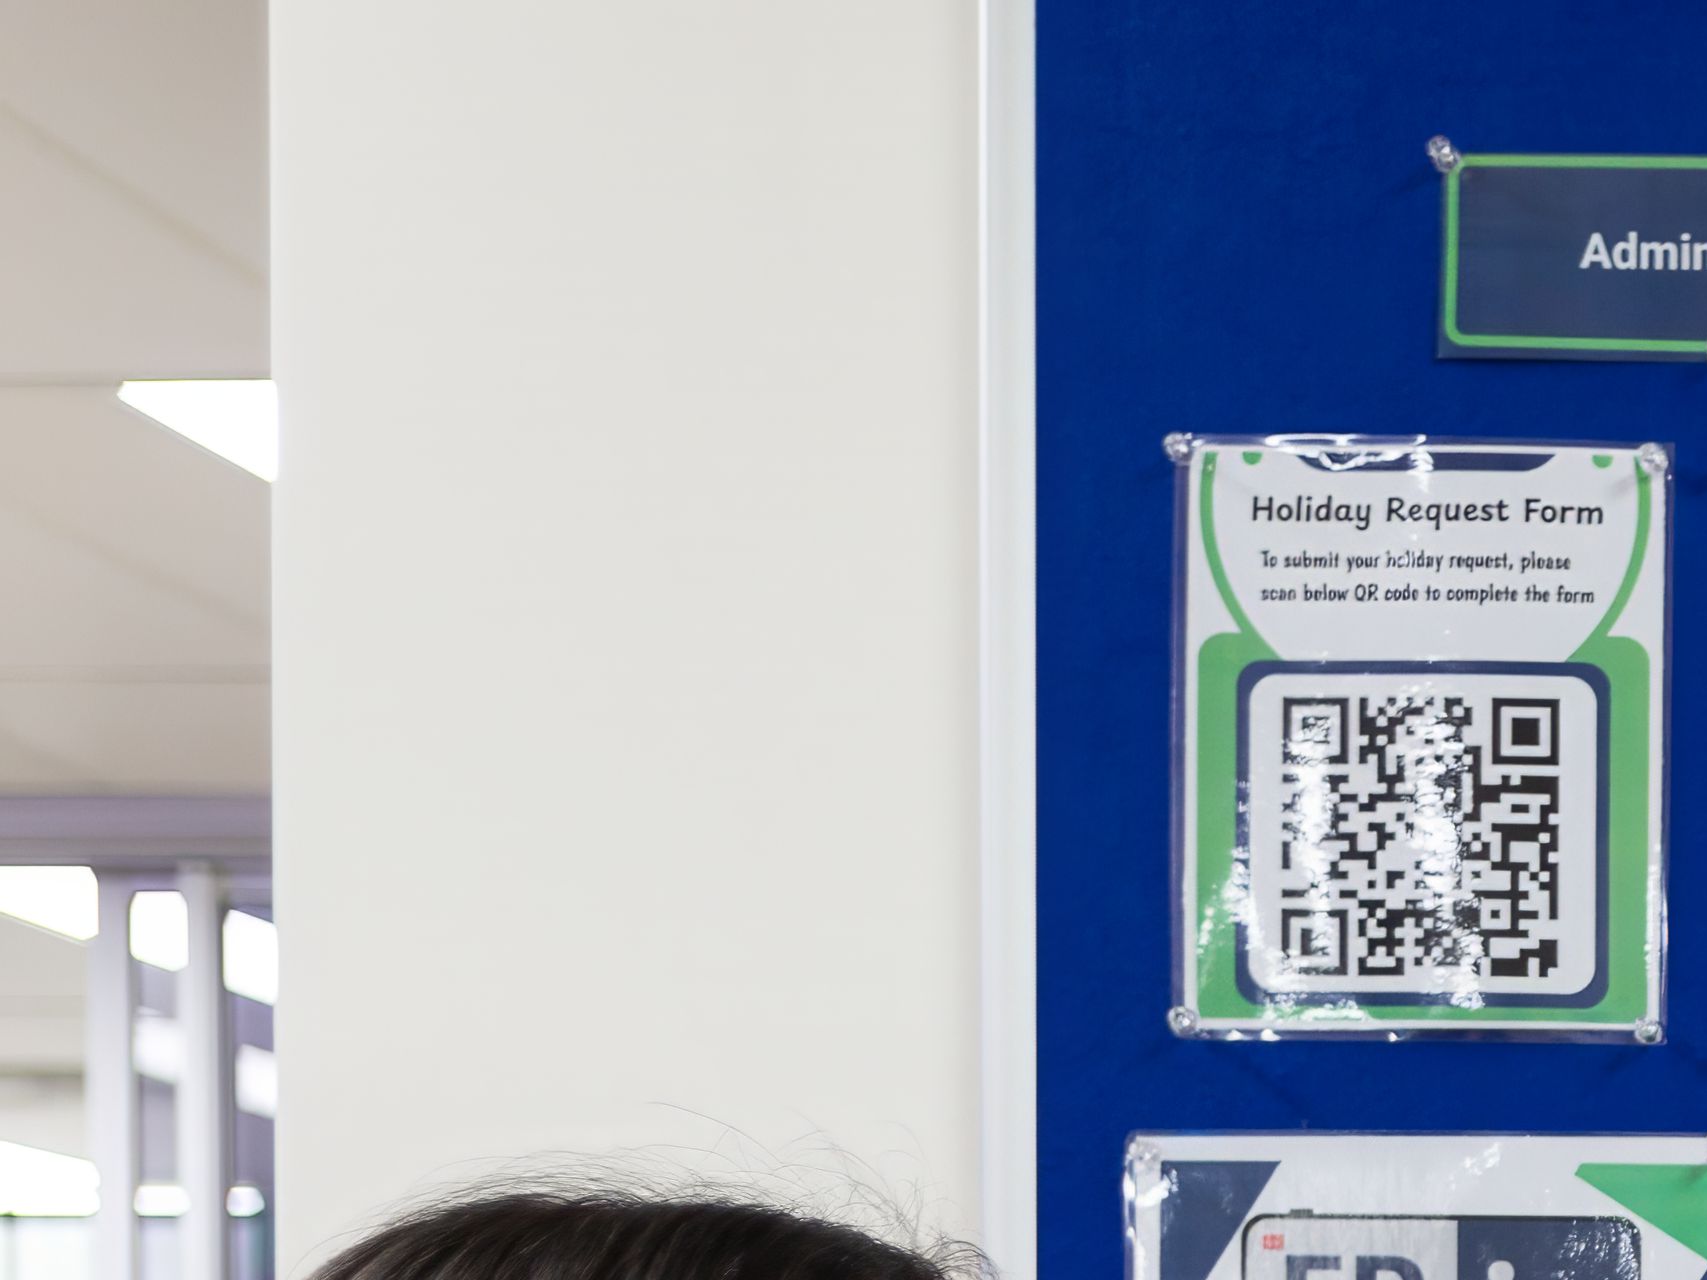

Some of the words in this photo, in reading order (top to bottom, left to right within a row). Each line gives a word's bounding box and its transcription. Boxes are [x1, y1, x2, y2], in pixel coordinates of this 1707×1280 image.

[1252, 495, 1371, 531] Holiday
[1386, 497, 1510, 531] Request
[1524, 498, 1604, 525] Form
